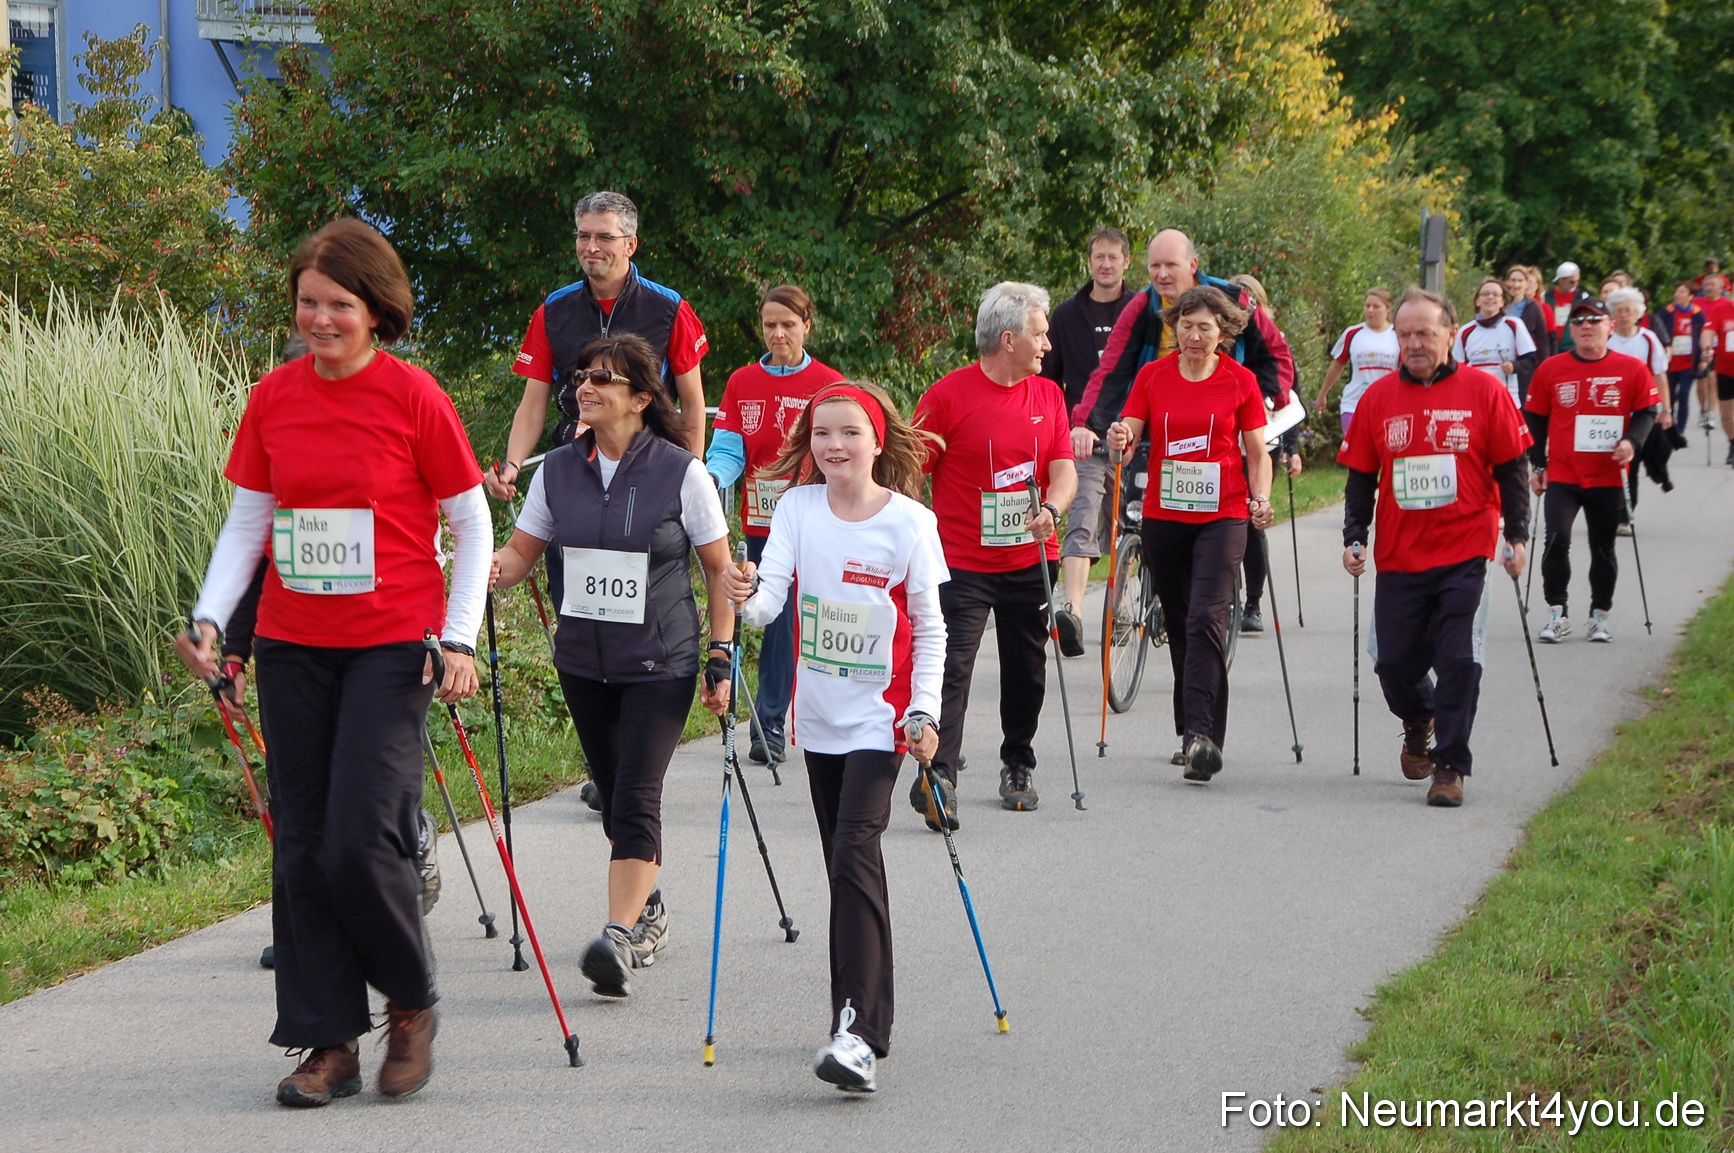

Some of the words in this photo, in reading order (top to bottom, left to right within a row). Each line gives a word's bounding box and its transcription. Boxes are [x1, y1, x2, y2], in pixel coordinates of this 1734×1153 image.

[742, 416, 759, 424] NEU
[1588, 429, 1618, 440] 8104
[1178, 441, 1197, 450] DEHN
[1175, 464, 1203, 476] Monika
[1407, 461, 1430, 472] Franz
[1006, 469, 1024, 481] DEHN
[1175, 480, 1215, 495] 8086
[1410, 474, 1451, 492] 8010
[761, 497, 777, 511] 80
[299, 514, 328, 532] Anke
[301, 542, 361, 565] 8001
[585, 575, 638, 599] 8103
[821, 604, 858, 624] Melina
[821, 629, 881, 655] 8007
